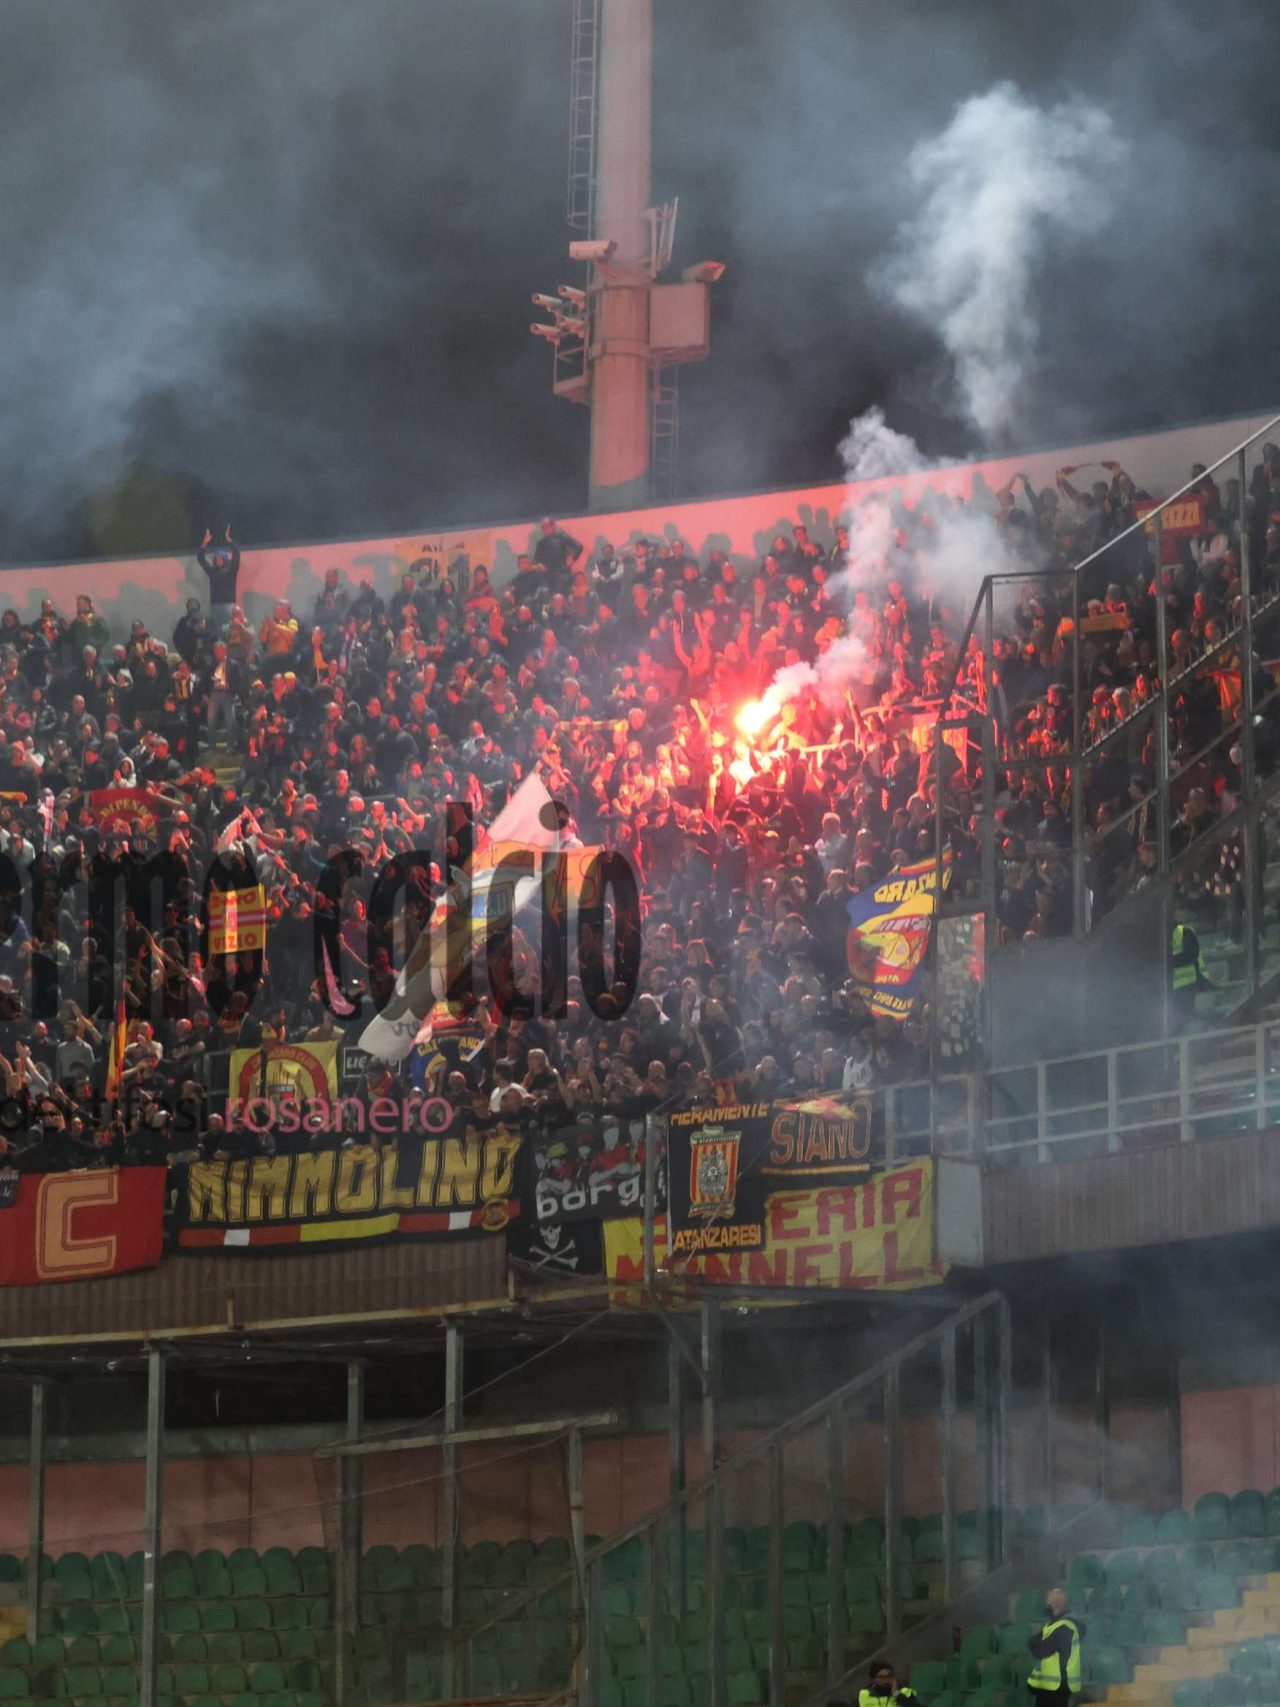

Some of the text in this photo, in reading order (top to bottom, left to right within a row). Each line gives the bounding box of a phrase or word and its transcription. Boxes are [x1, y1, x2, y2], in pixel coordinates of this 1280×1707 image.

[188, 1132, 522, 1224] MIMMOLINO
[36, 1170, 118, 1279] C
[673, 1224, 761, 1250] ATANZARESI
